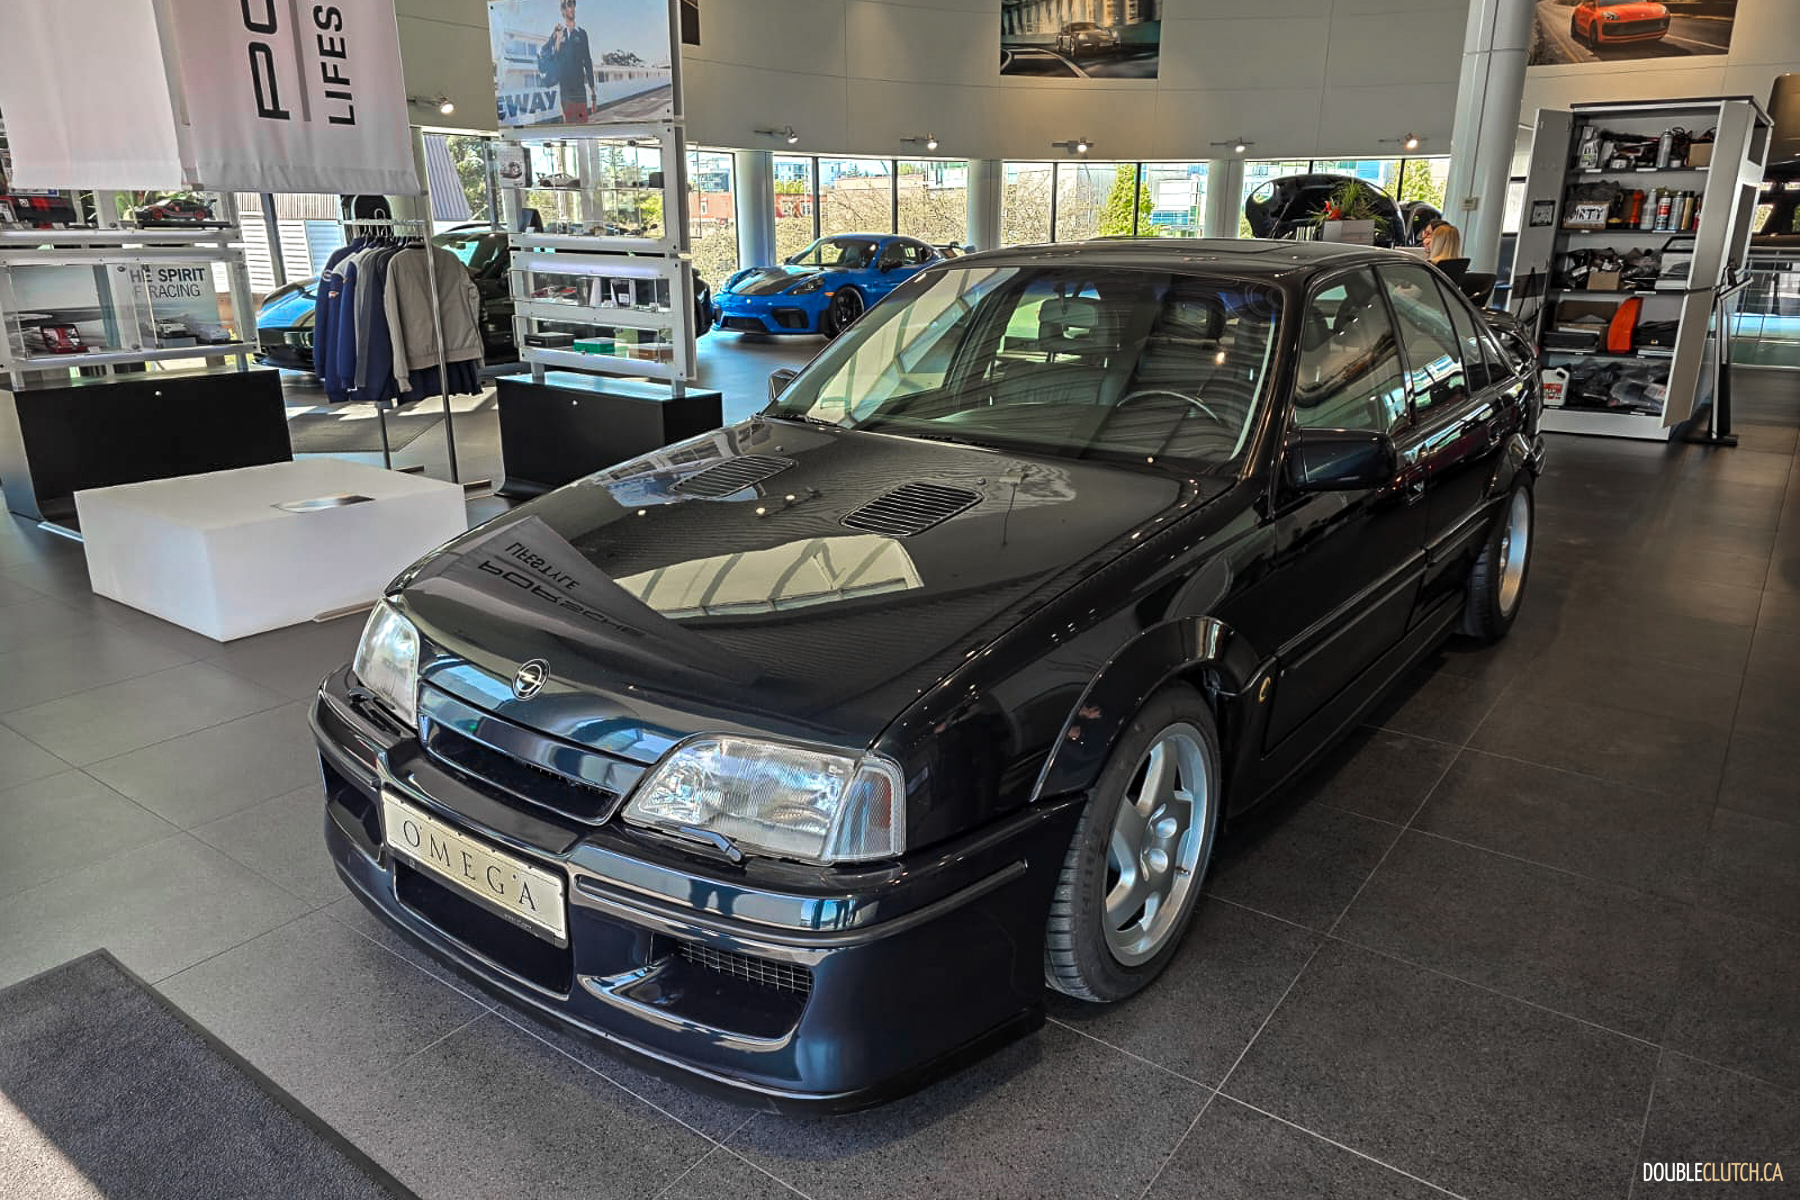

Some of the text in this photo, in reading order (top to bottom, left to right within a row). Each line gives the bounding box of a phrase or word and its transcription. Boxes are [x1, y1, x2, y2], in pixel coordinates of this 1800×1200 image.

[158, 268, 205, 282] SPIRIT
[149, 284, 200, 298] RACING
[403, 819, 537, 912] OMEGA
